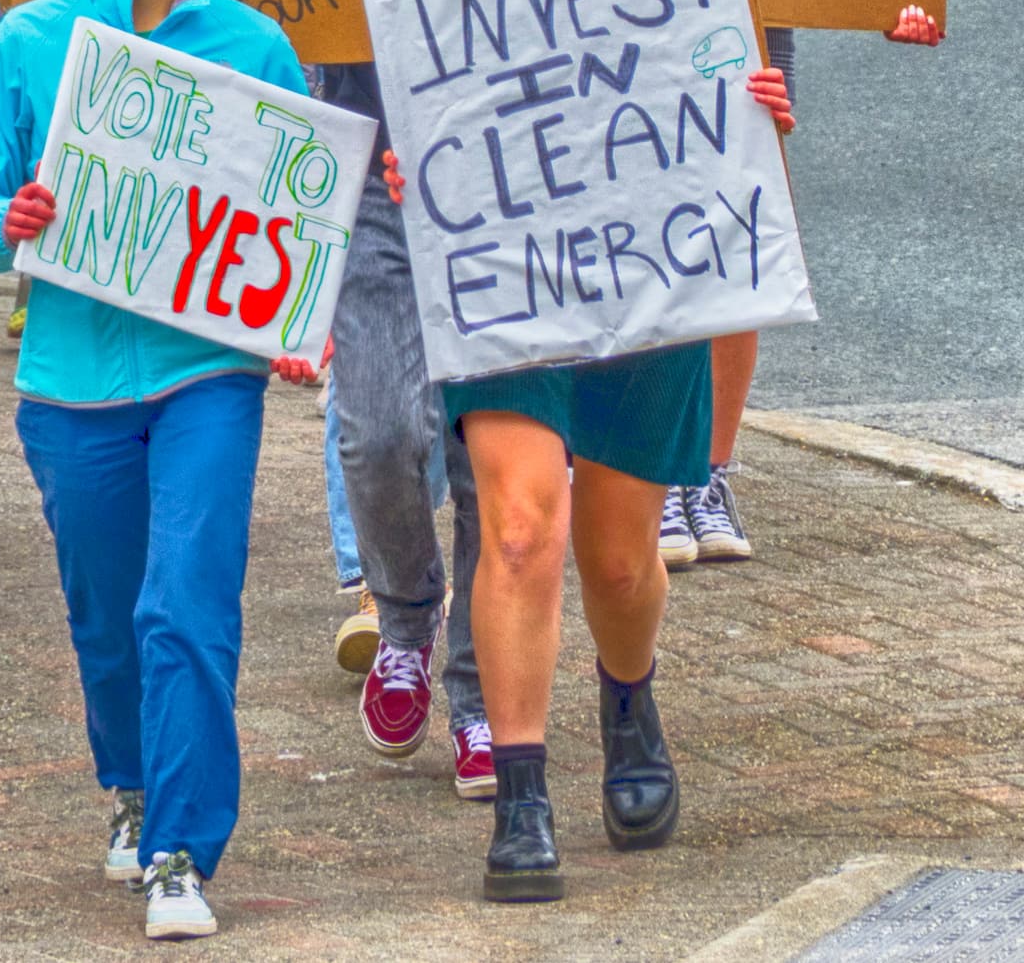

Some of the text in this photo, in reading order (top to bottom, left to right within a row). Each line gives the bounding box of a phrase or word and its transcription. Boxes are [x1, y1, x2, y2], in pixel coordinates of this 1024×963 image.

[71, 29, 338, 208] VOTE TO
[417, 76, 726, 234] CLEAN
[486, 42, 641, 118] IN
[445, 184, 762, 335] ENERGY
